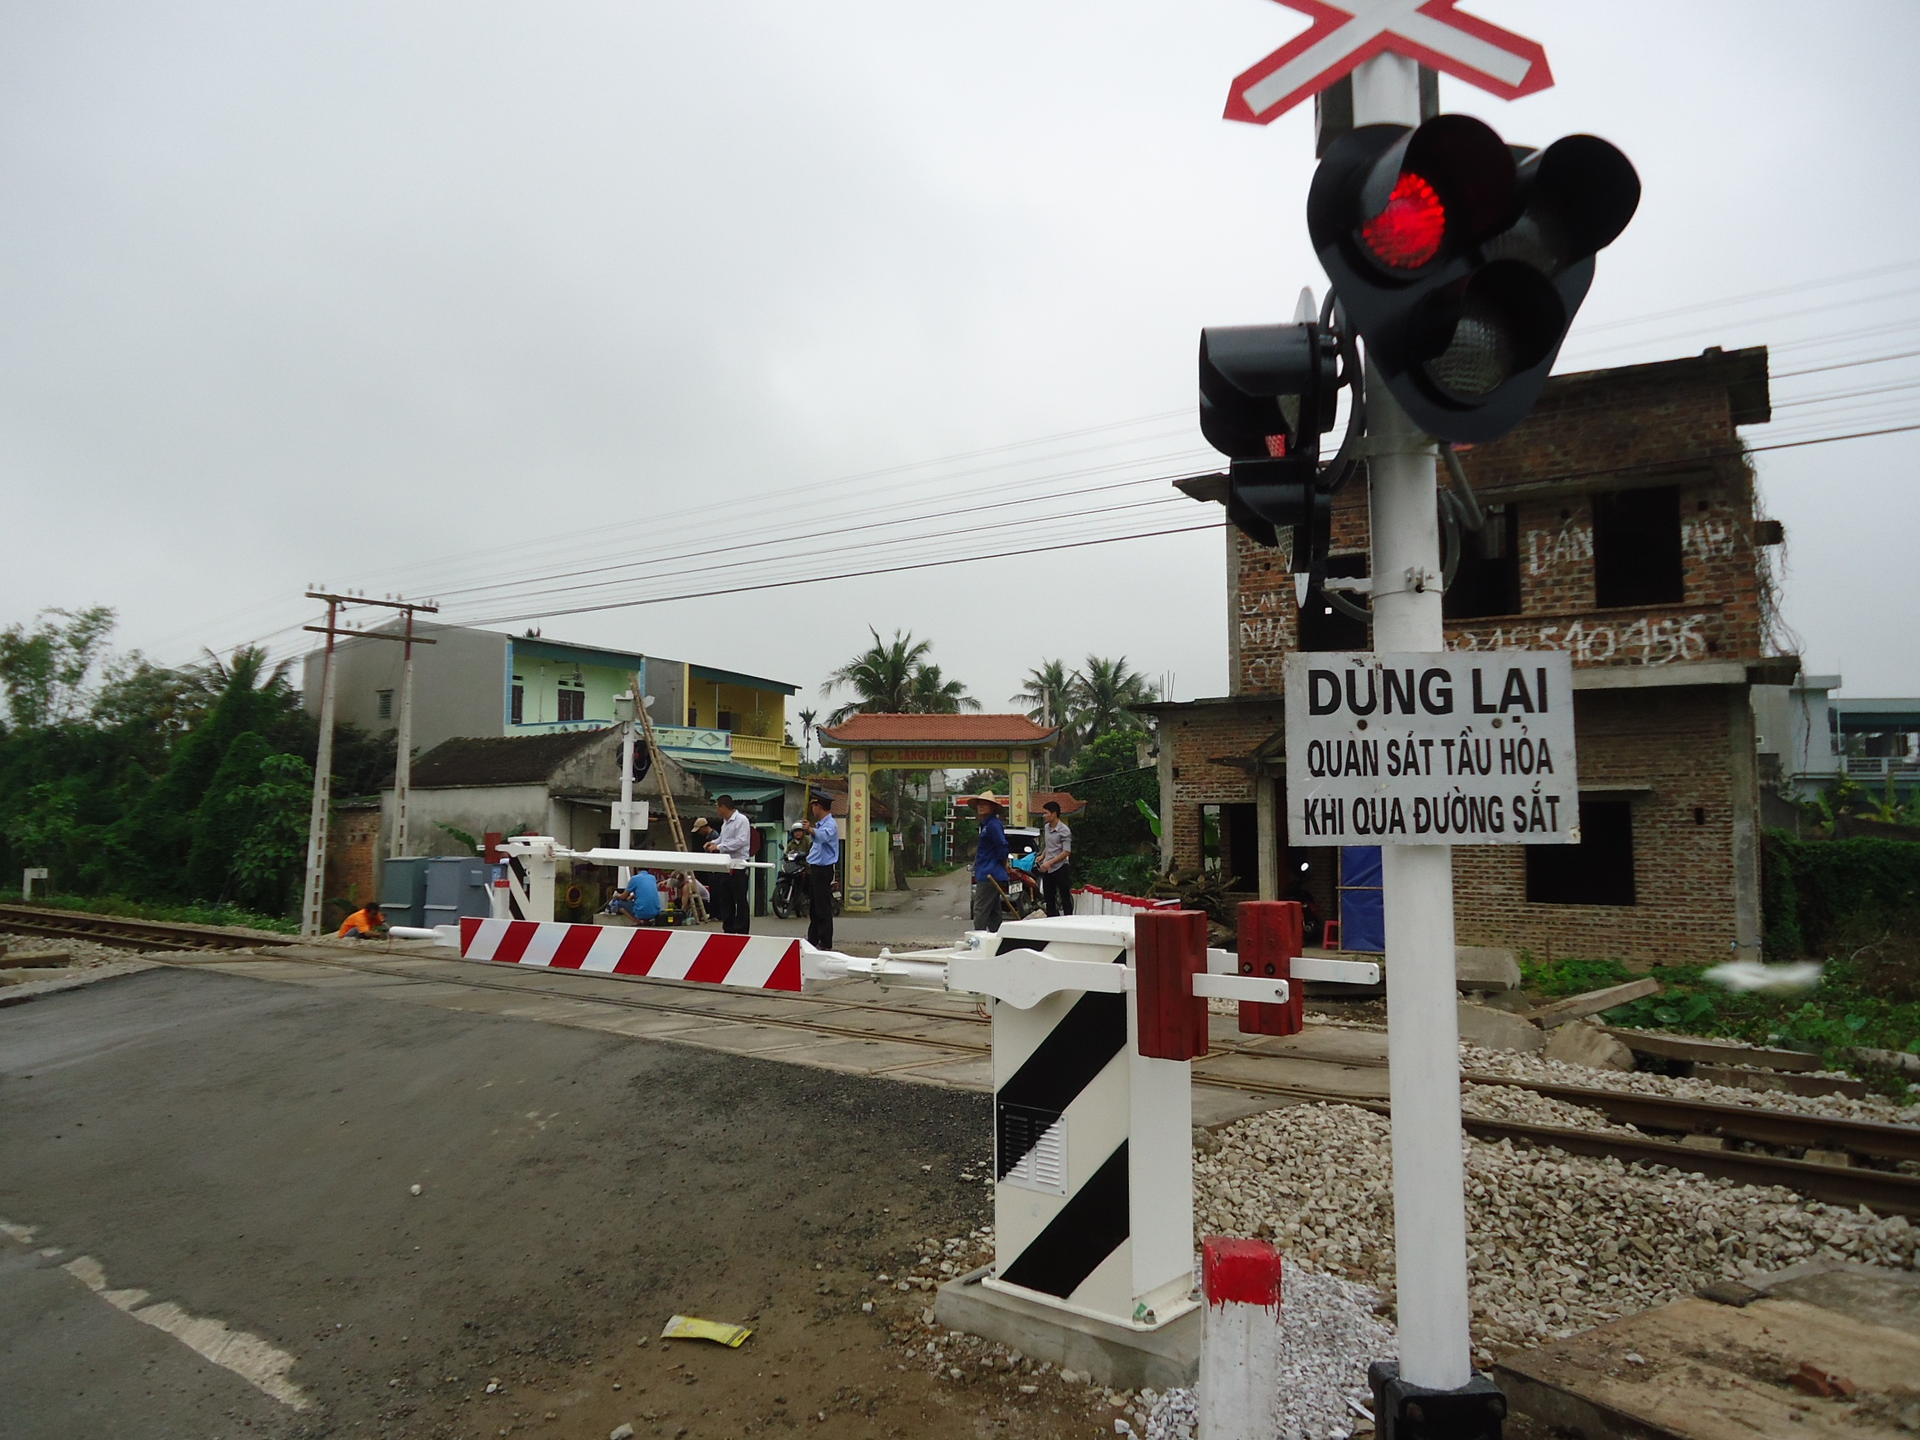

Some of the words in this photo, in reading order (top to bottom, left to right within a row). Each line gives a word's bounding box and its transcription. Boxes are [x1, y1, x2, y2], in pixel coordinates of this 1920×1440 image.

[1472, 667, 1549, 723] LẠI
[1308, 738, 1379, 777] QUAN
[1387, 730, 1435, 777] SÁT
[1441, 725, 1492, 776] TẦU
[1500, 725, 1554, 775] HỎA
[1304, 798, 1344, 835] KHI
[1352, 797, 1406, 835] QUA
[1413, 786, 1505, 834] ĐƯỜNG
[1513, 781, 1561, 833] SẮT
